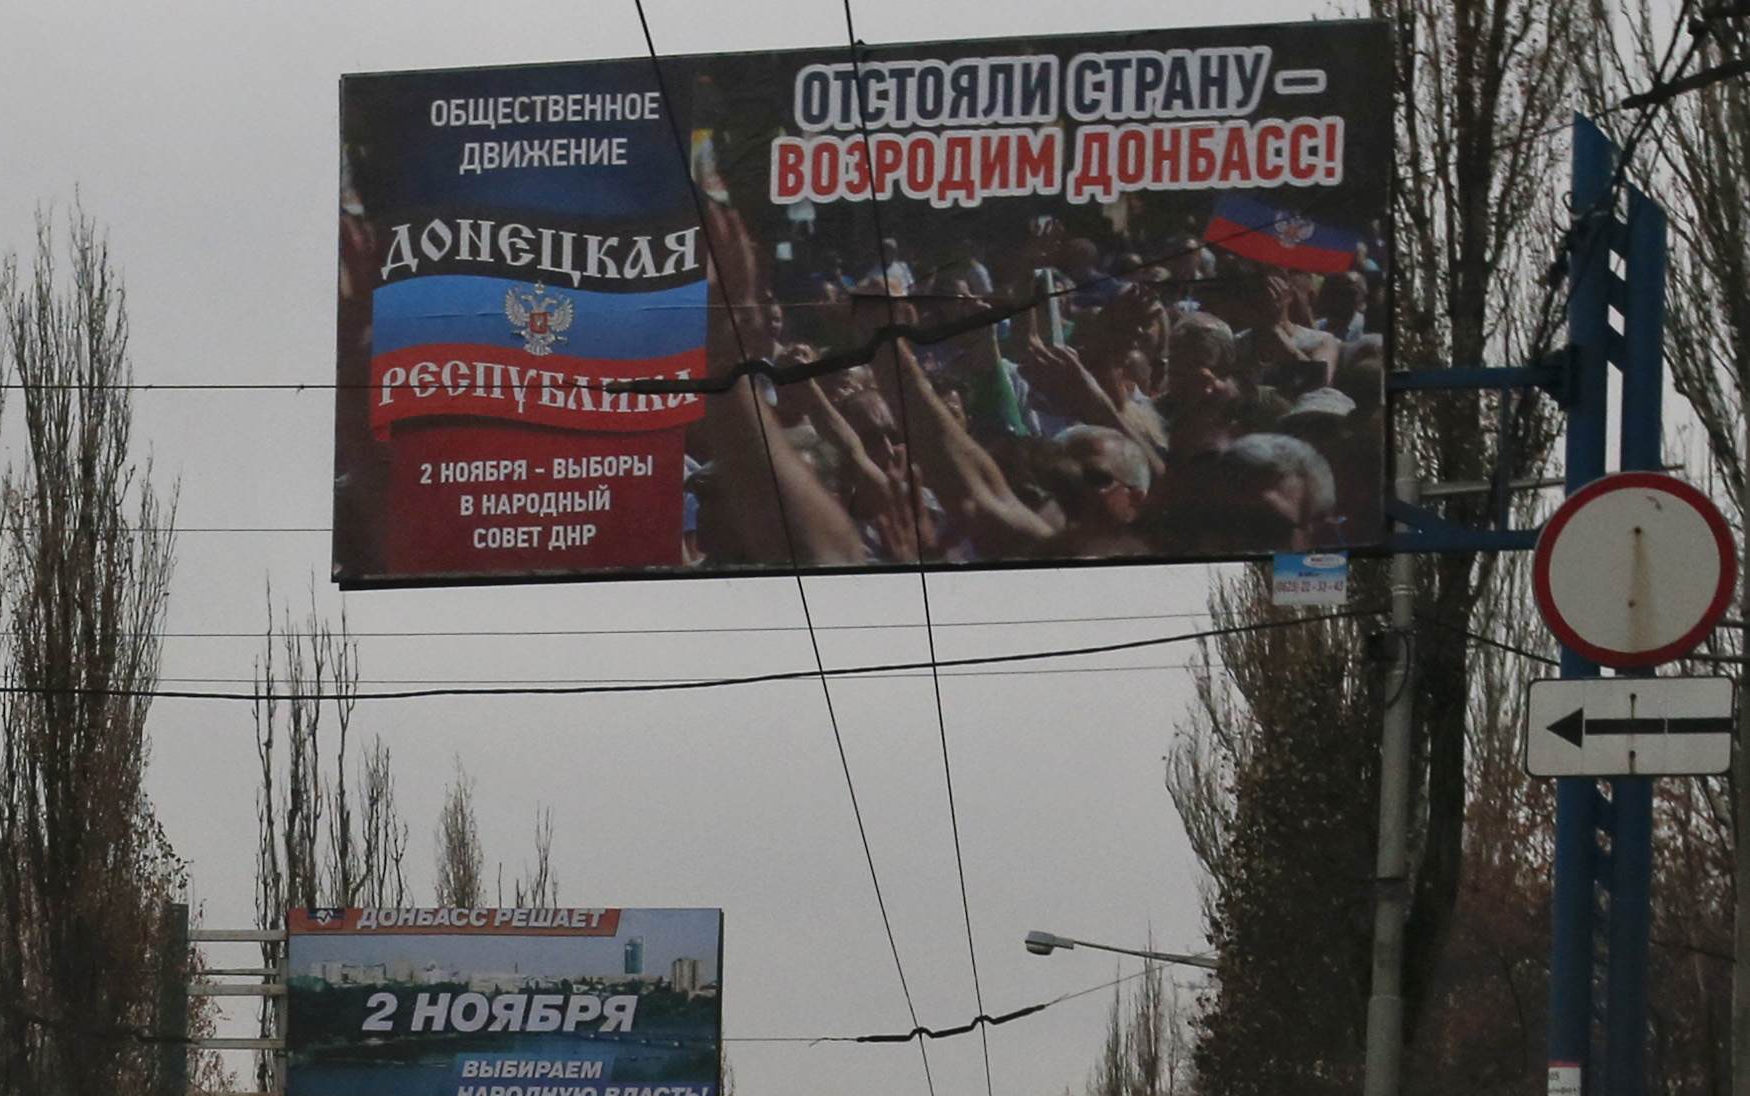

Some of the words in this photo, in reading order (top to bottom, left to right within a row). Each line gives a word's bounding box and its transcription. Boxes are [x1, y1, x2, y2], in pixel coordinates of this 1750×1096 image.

[797, 57, 1056, 130] ОТСТОЯЛИ
[1069, 48, 1269, 119] СТРАНУ
[430, 92, 661, 129] ОБЩЕСТВЕННОЕ
[459, 138, 628, 175] ДВИЖЕНИЕ
[773, 129, 1060, 206] ВОЗРОДИМ
[1069, 119, 1341, 201] ДОНБАСС!
[381, 218, 700, 287] ДОНЕЦКАЯ
[419, 464, 432, 484] 2
[440, 460, 527, 483] НОЯБРЯ
[553, 456, 653, 479] ВЫБОРЫ
[460, 495, 474, 516] В
[481, 485, 611, 517] НАРОДНЫЙ
[473, 527, 542, 549] СОВЕТ
[549, 525, 596, 551] ДНР
[357, 908, 489, 930] ДОНБАСС
[494, 908, 606, 929] РЕШАЕТ
[362, 992, 399, 1031] 2
[411, 993, 638, 1032] НОЯБРЯ
[461, 1061, 603, 1079] ВЫБИРАЕМ
